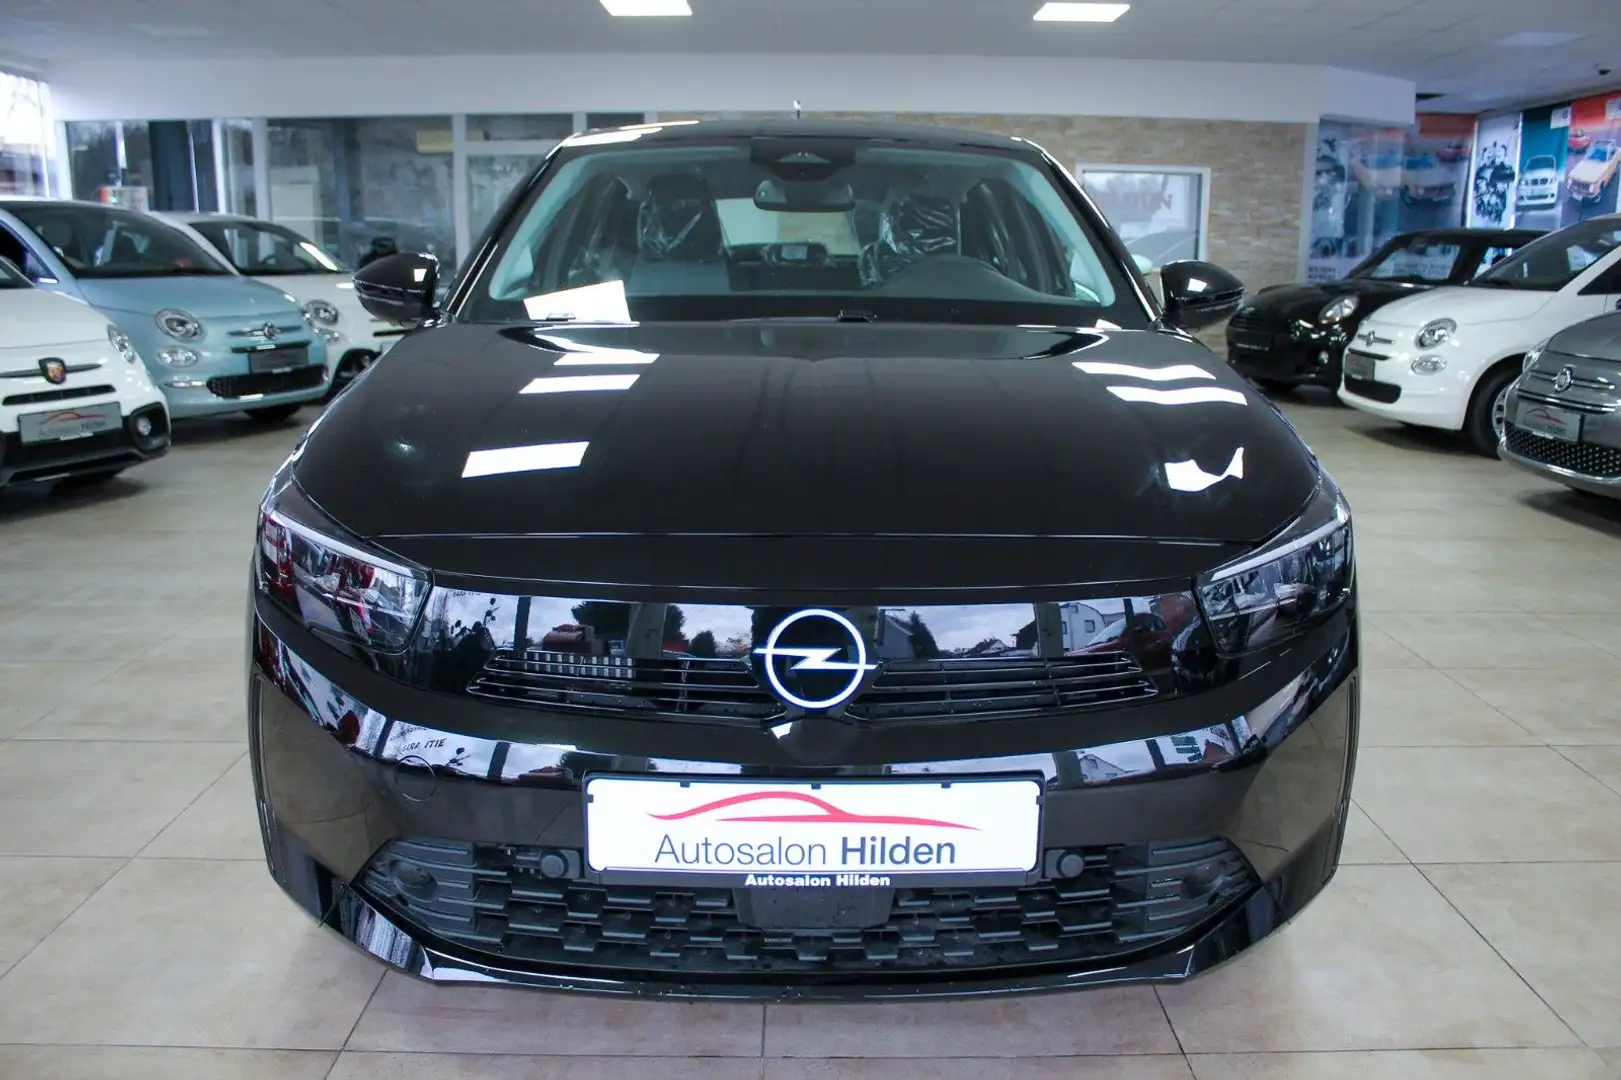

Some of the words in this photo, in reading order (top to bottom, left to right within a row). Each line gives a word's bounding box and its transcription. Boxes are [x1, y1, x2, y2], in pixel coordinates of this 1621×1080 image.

[654, 833, 826, 866] Autosalon
[842, 835, 956, 866] Hilden
[744, 874, 831, 887] Autosalon
[835, 874, 891, 887] Hilden
